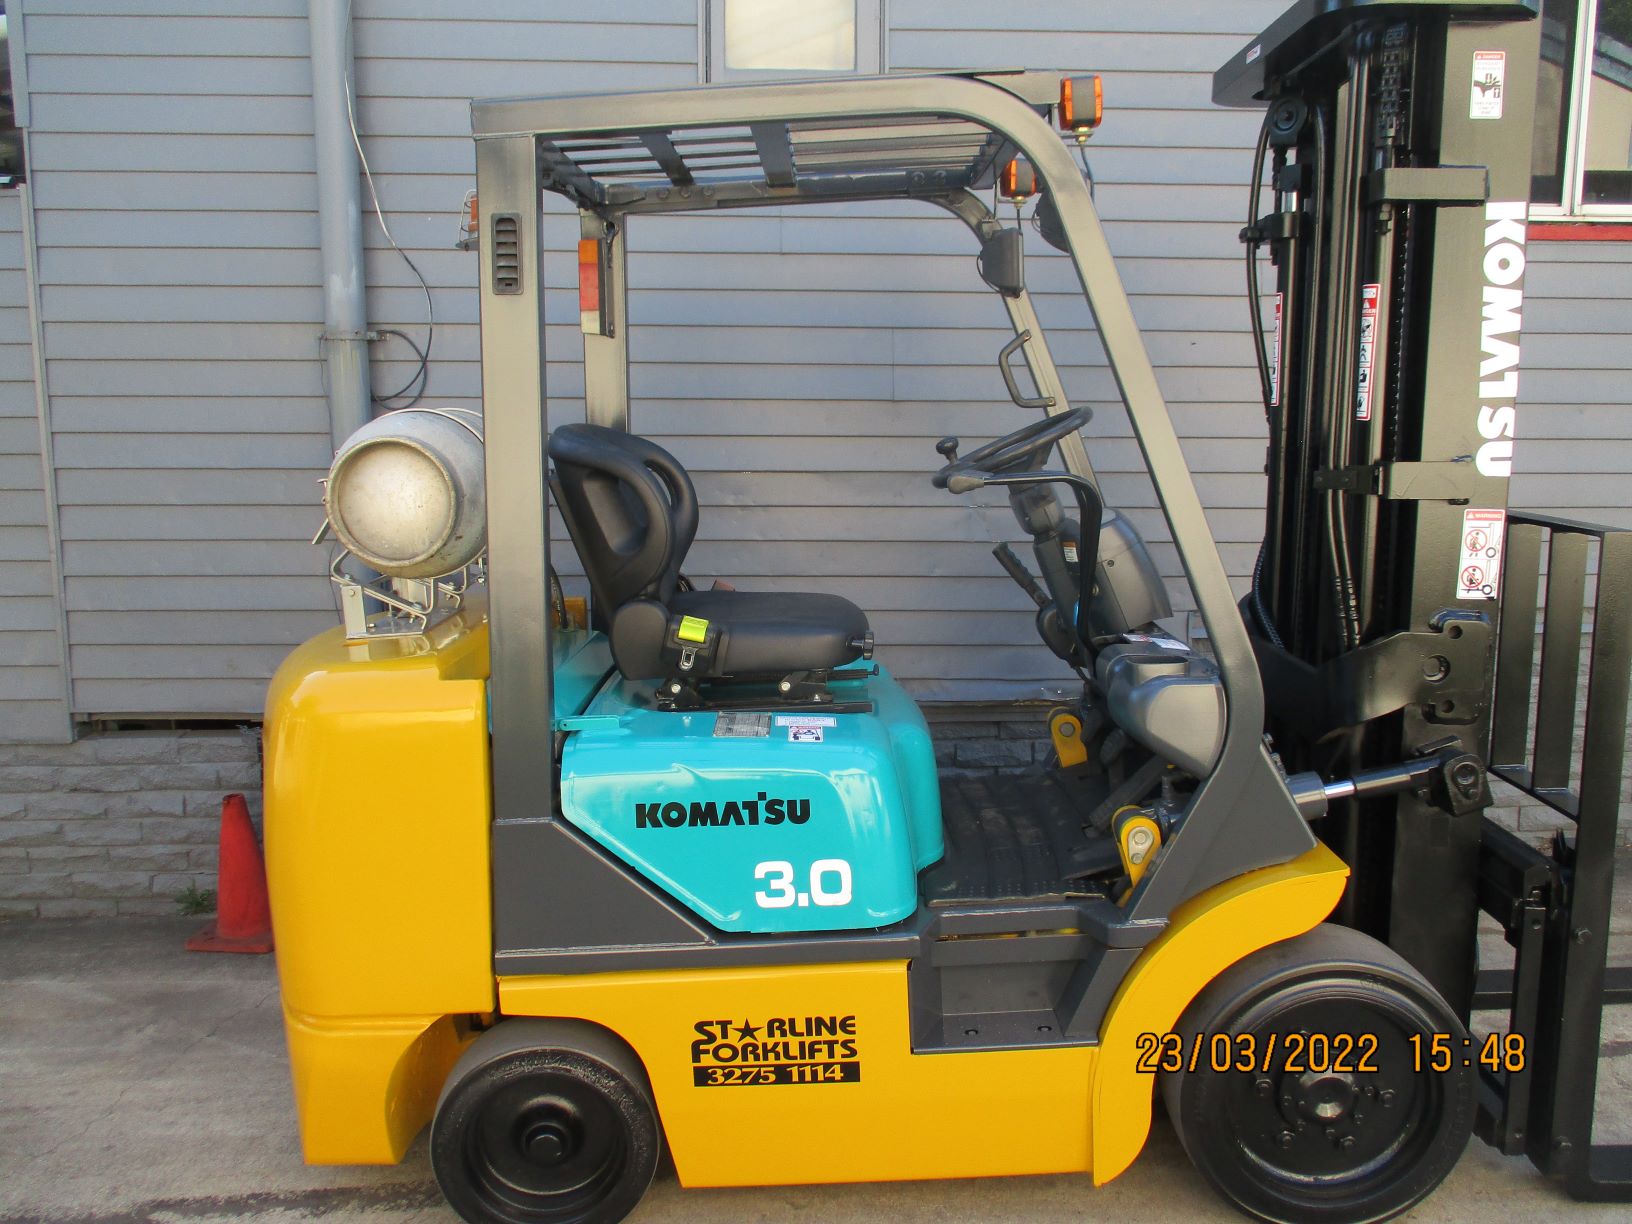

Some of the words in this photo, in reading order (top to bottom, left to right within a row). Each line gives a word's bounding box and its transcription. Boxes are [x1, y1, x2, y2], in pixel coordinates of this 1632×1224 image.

[1475, 201, 1527, 477] KOMATSU
[635, 791, 811, 828] KOMATSU
[754, 858, 852, 908] 3.0
[691, 1038, 858, 1063] FORKLIFTS
[707, 1067, 776, 1085] 3275
[786, 1064, 844, 1082] 1114
